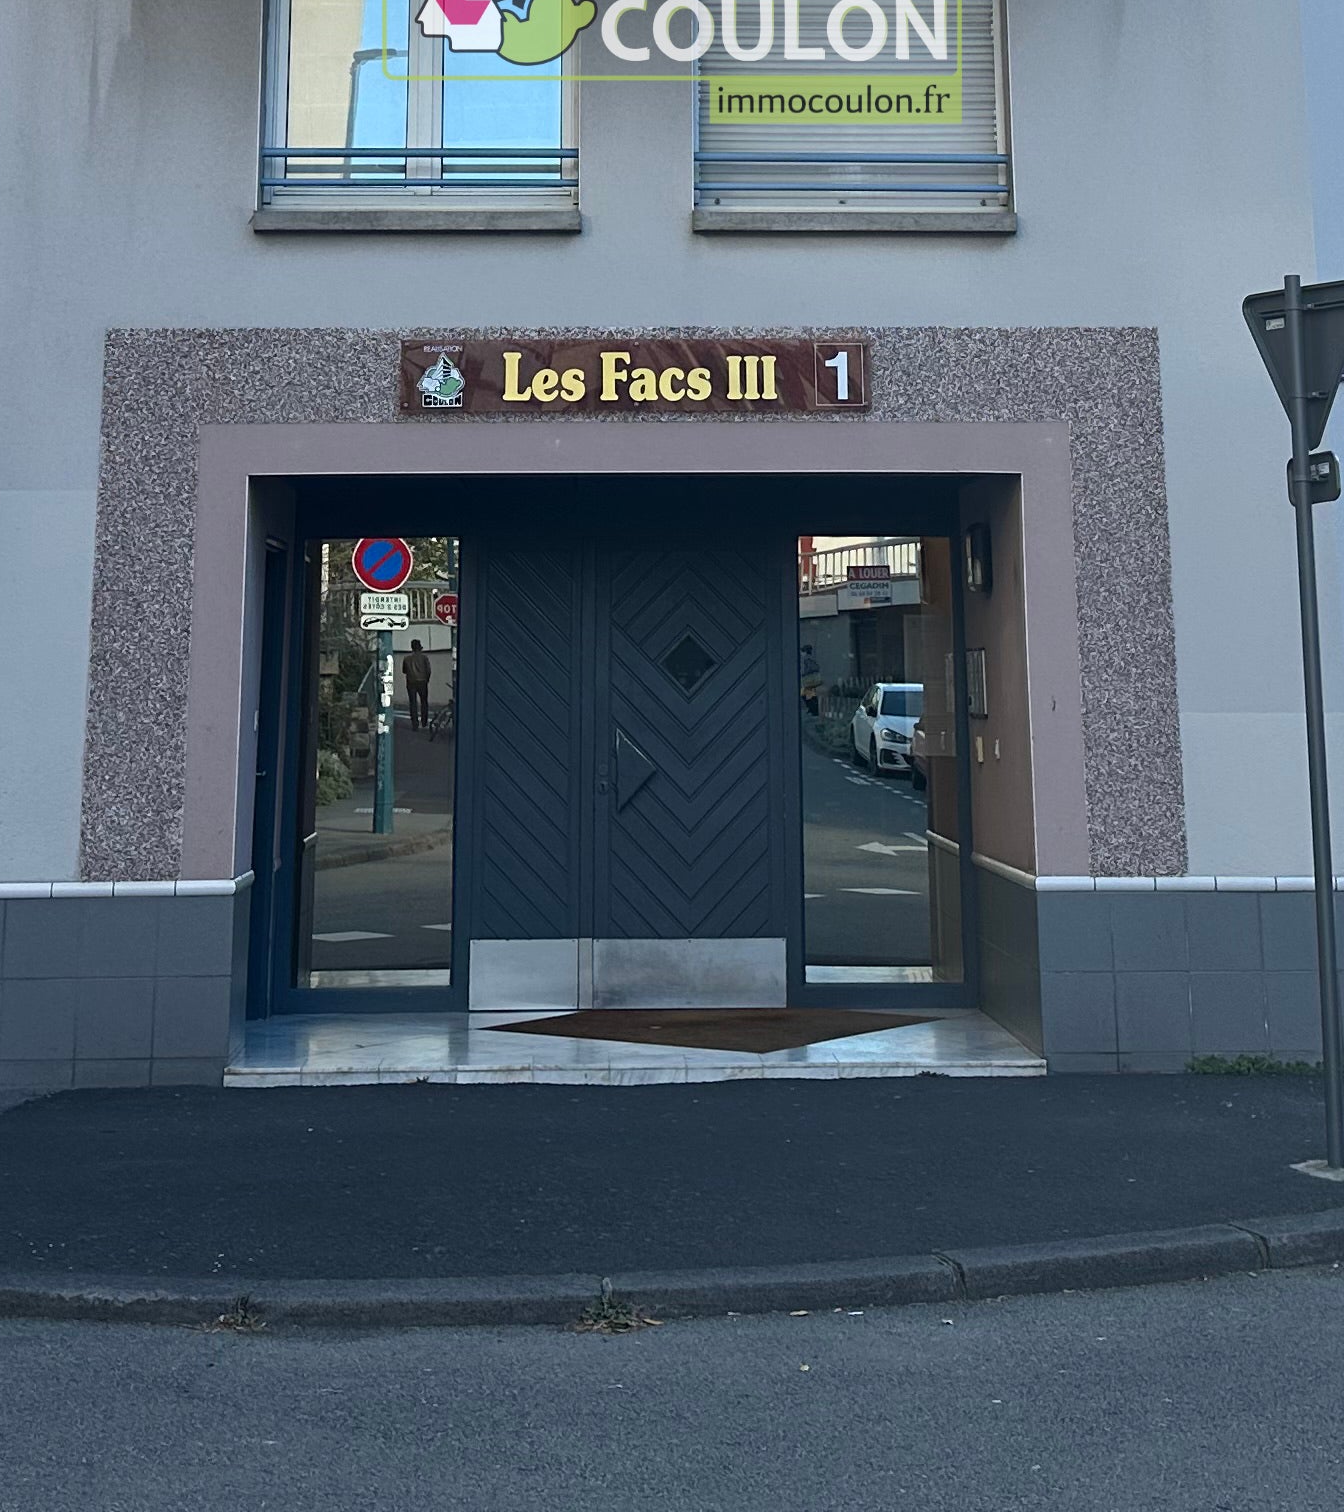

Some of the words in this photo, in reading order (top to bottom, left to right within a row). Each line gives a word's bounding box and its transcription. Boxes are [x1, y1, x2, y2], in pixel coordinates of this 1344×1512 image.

[501, 351, 587, 402] Les
[599, 351, 712, 402] Facs
[726, 354, 778, 401] III
[824, 351, 849, 401] 1
[859, 567, 890, 579] LOUER
